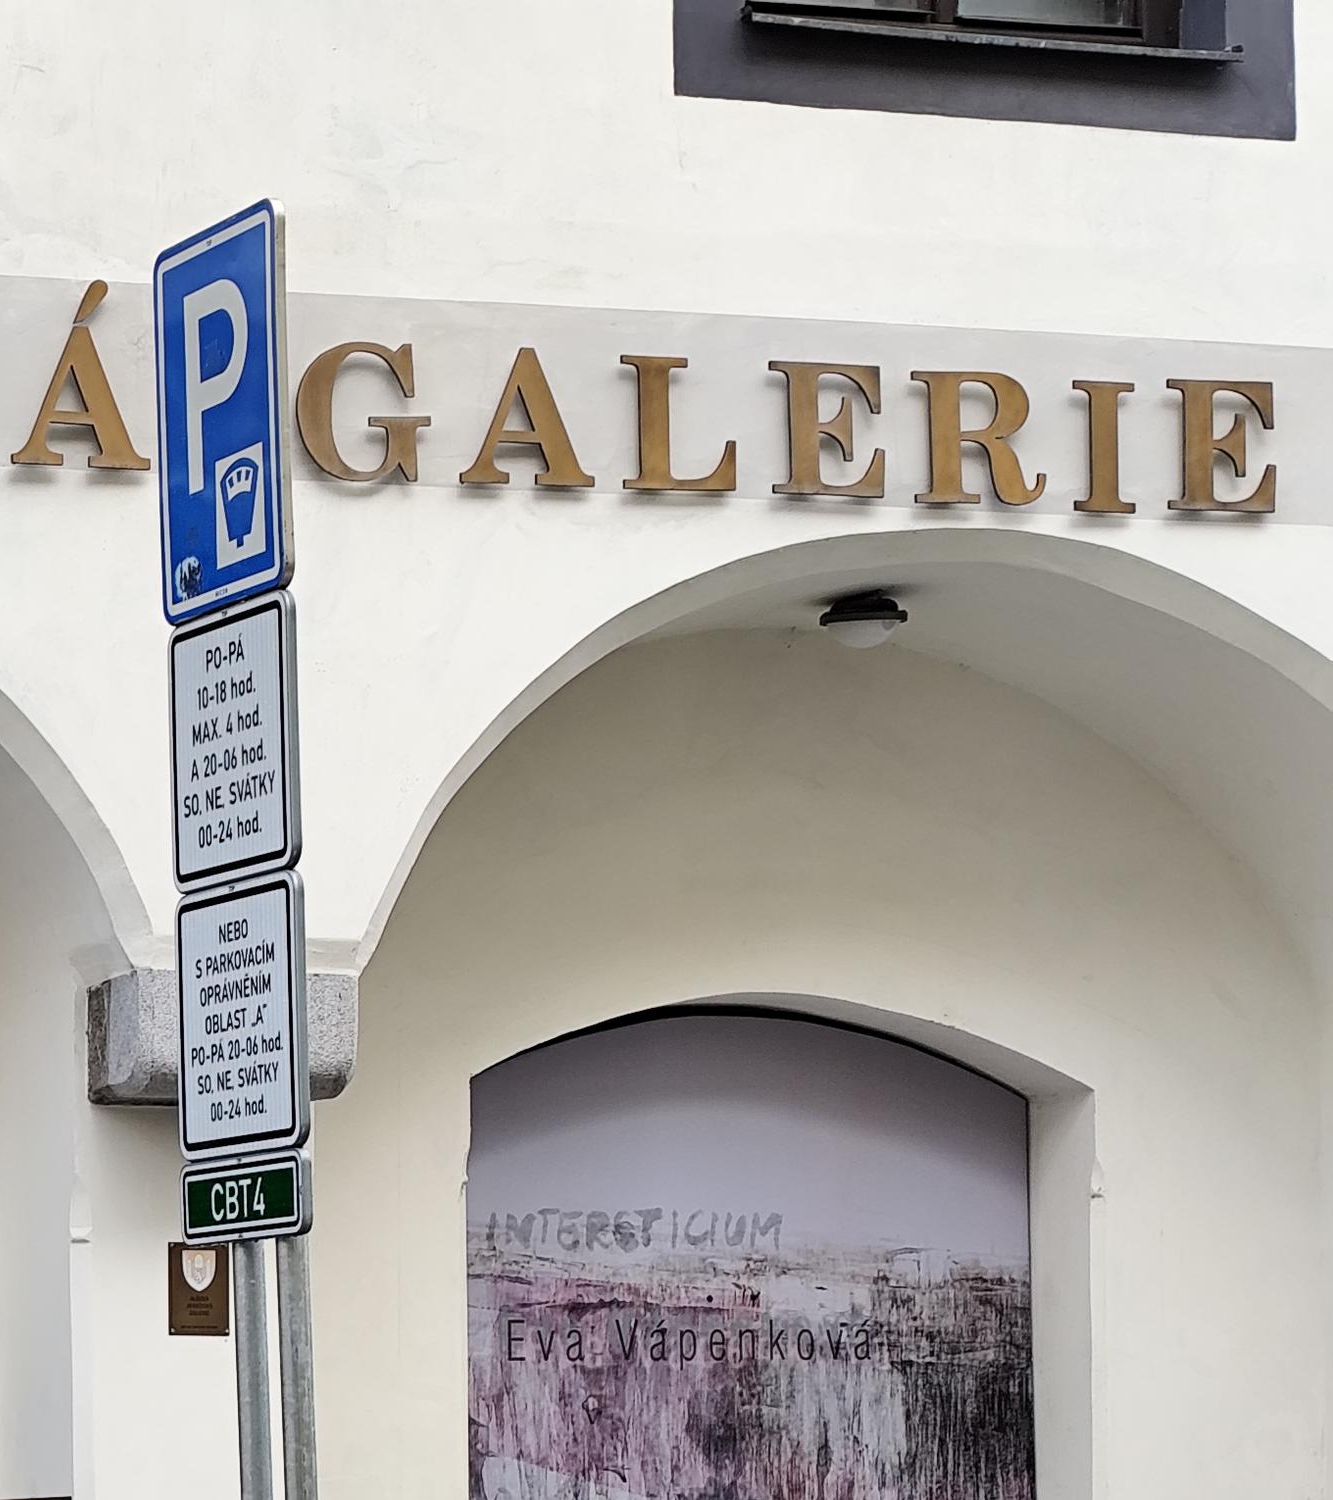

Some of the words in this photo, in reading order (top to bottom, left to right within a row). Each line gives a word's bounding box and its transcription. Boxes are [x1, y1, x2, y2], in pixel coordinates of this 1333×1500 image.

[182, 277, 249, 497] P
[295, 341, 1276, 514] GALERIE
[205, 633, 245, 673] PO-PÁ
[197, 680, 227, 710] 10-18
[231, 670, 257, 701] hod.
[192, 716, 222, 747] MAX.
[225, 713, 233, 736] 4
[237, 704, 263, 732] hod.
[191, 759, 199, 783] A
[203, 746, 238, 779] 20-06
[241, 738, 267, 767] hod.
[229, 770, 276, 805] SVÁTKY
[198, 818, 233, 849] 00-24
[237, 810, 262, 839] hod.
[219, 918, 249, 944] NEBO
[195, 958, 203, 979] S
[205, 939, 275, 977] PARKOVACÍM
[205, 1008, 248, 1035] OBLAST
[191, 1039, 225, 1068] PO-PÁ
[227, 1035, 259, 1061] 20-06
[261, 1030, 284, 1054] hod.
[237, 1060, 279, 1088] SVÁTKY
[210, 1098, 242, 1122] 00-24
[245, 1093, 268, 1117] hod.
[210, 1176, 266, 1222] CBT4
[506, 1318, 585, 1363] Eva
[614, 1318, 873, 1371] Vápenková
